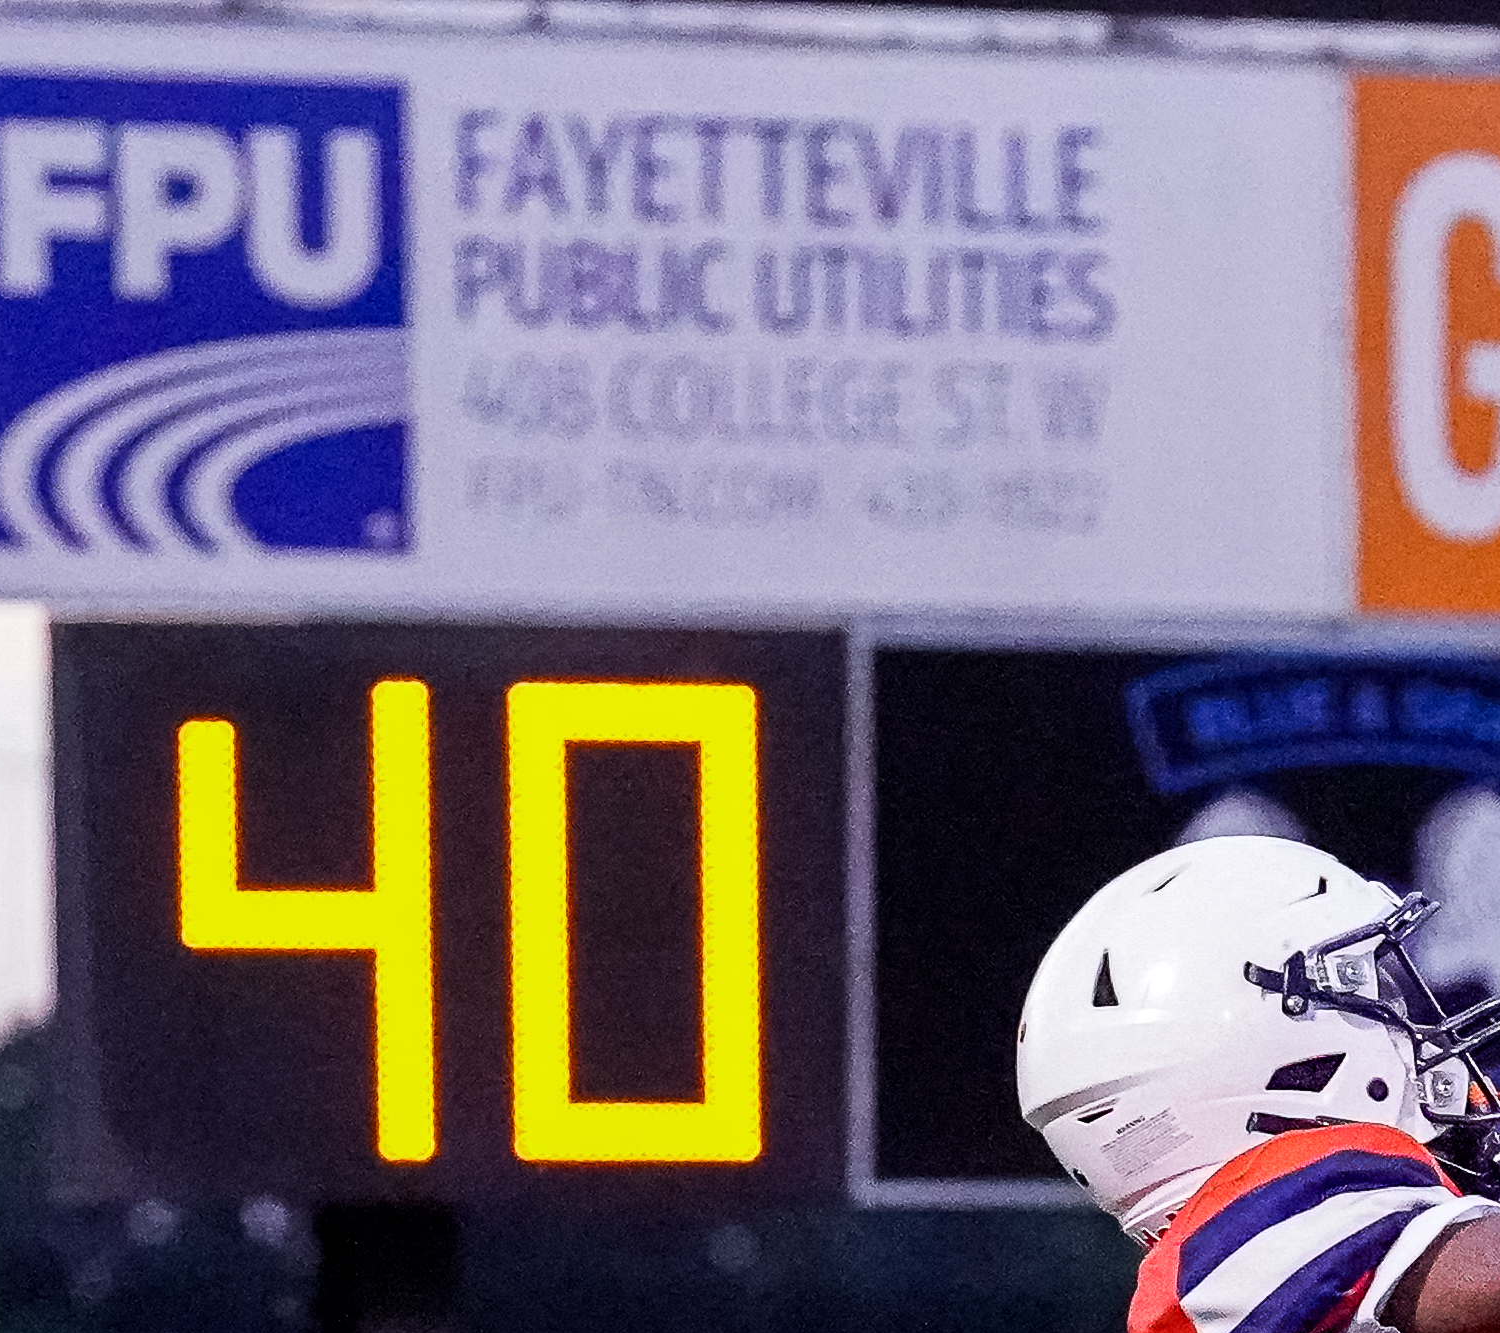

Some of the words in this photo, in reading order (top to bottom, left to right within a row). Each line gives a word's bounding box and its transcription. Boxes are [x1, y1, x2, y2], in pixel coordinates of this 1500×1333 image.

[451, 109, 1106, 235] FAYETTEVILLE
[451, 235, 736, 335] PUBLIC
[753, 243, 1118, 342] UTILITIES
[607, 355, 909, 446] COLLEGE
[177, 676, 764, 1165] 40
